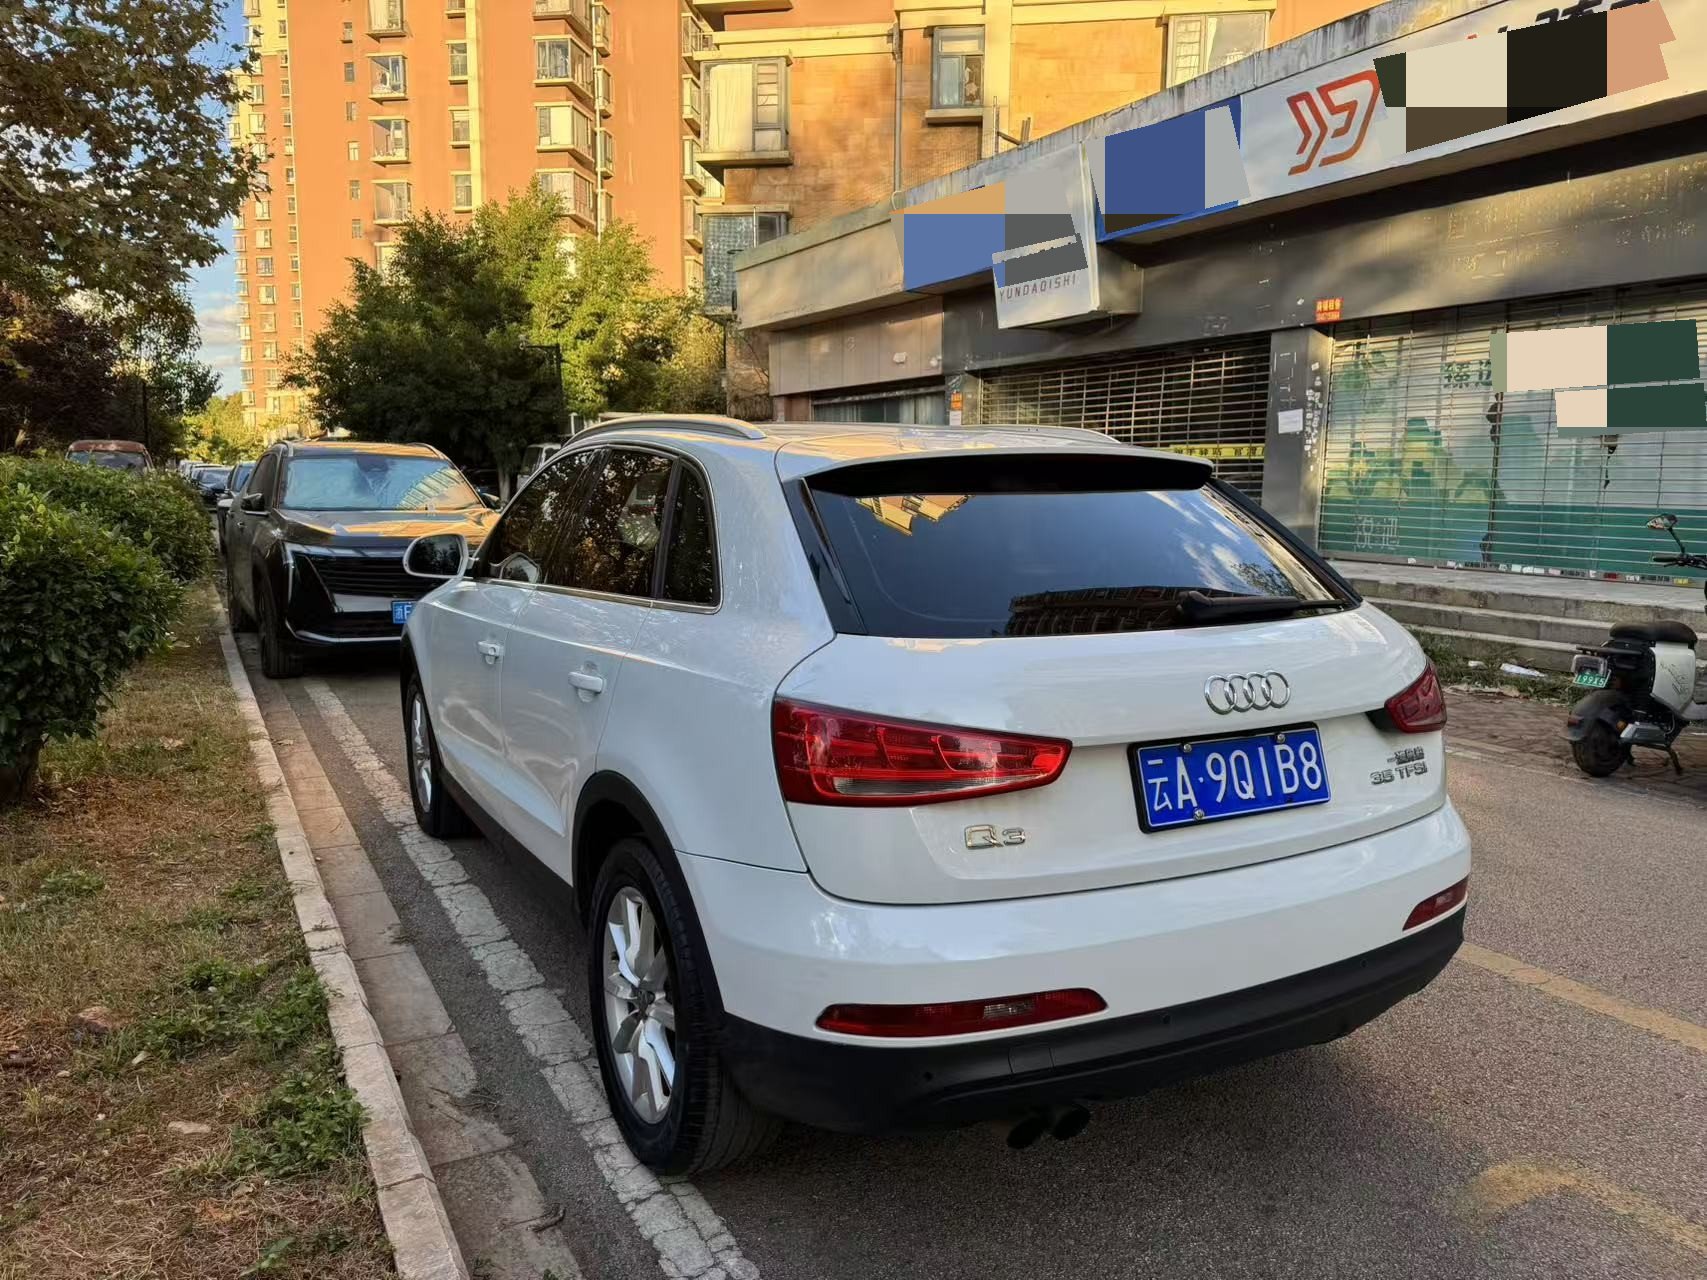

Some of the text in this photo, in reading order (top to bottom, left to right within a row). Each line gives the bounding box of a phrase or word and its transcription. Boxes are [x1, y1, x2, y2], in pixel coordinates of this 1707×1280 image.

[1370, 761, 1428, 785] 35 TFSI
[964, 824, 1026, 850] Q3
